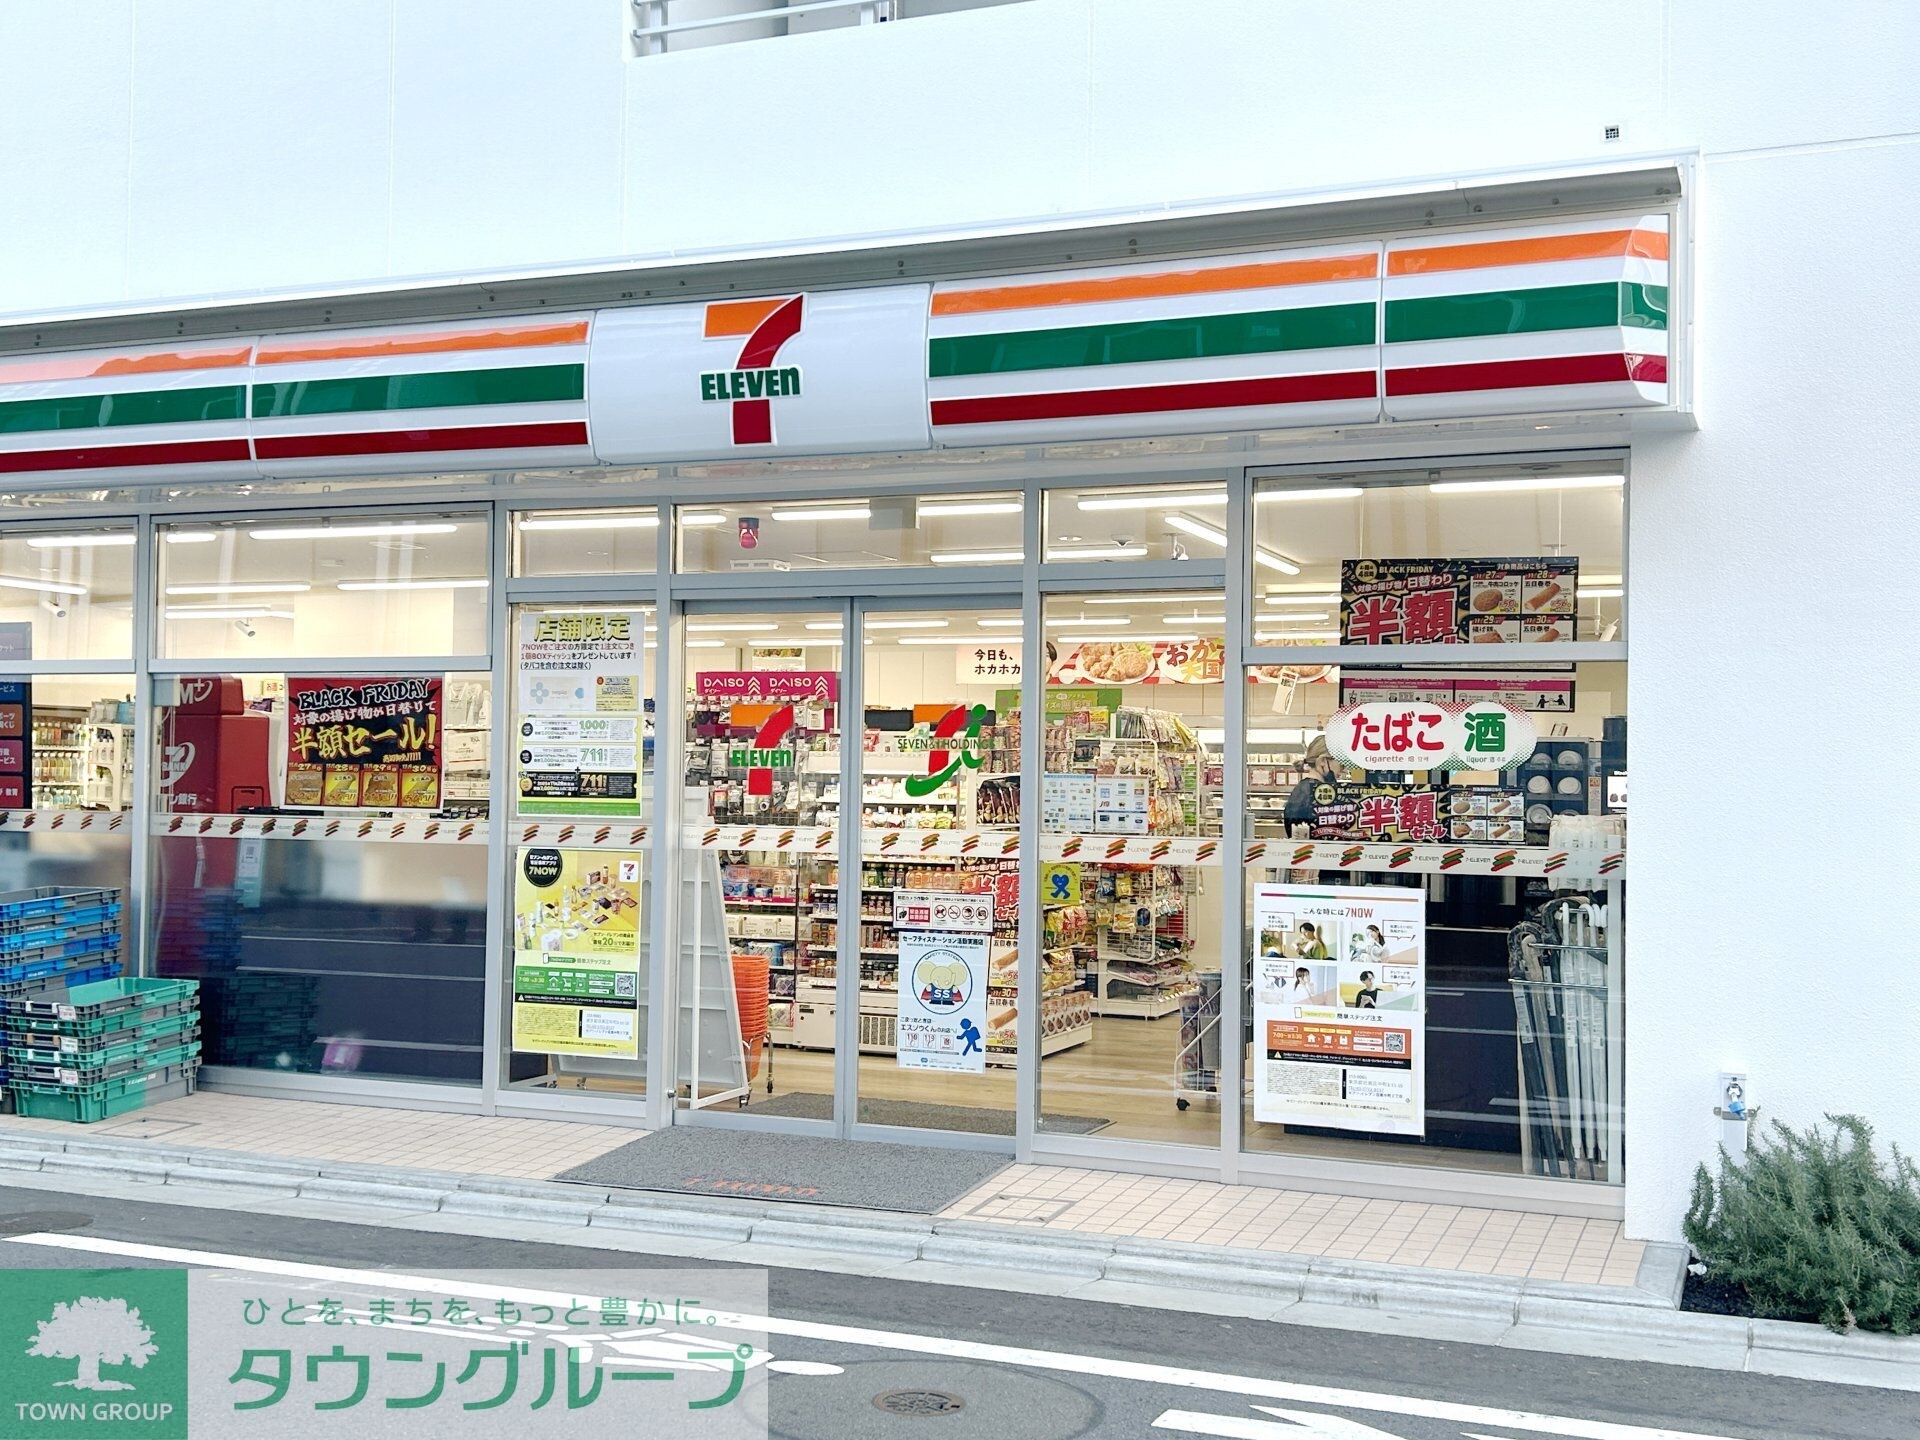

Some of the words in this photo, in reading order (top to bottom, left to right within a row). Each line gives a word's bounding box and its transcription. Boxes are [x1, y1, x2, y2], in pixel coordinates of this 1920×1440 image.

[704, 294, 804, 445] 7
[534, 614, 631, 642] 店舗限定
[1350, 590, 1456, 645] 半額
[974, 649, 1013, 661] 今日も、
[974, 664, 1021, 675] ホカホカ
[298, 687, 356, 711] BLACK
[361, 678, 431, 704] FRIDAY
[1351, 711, 1444, 752] たばこ
[1464, 711, 1506, 752] 酒
[1359, 793, 1437, 833] 半額
[1411, 825, 1447, 840] セール
[529, 866, 558, 875] 7NOW
[1302, 908, 1345, 916] こんな時には
[1345, 907, 1374, 919] 7NOW
